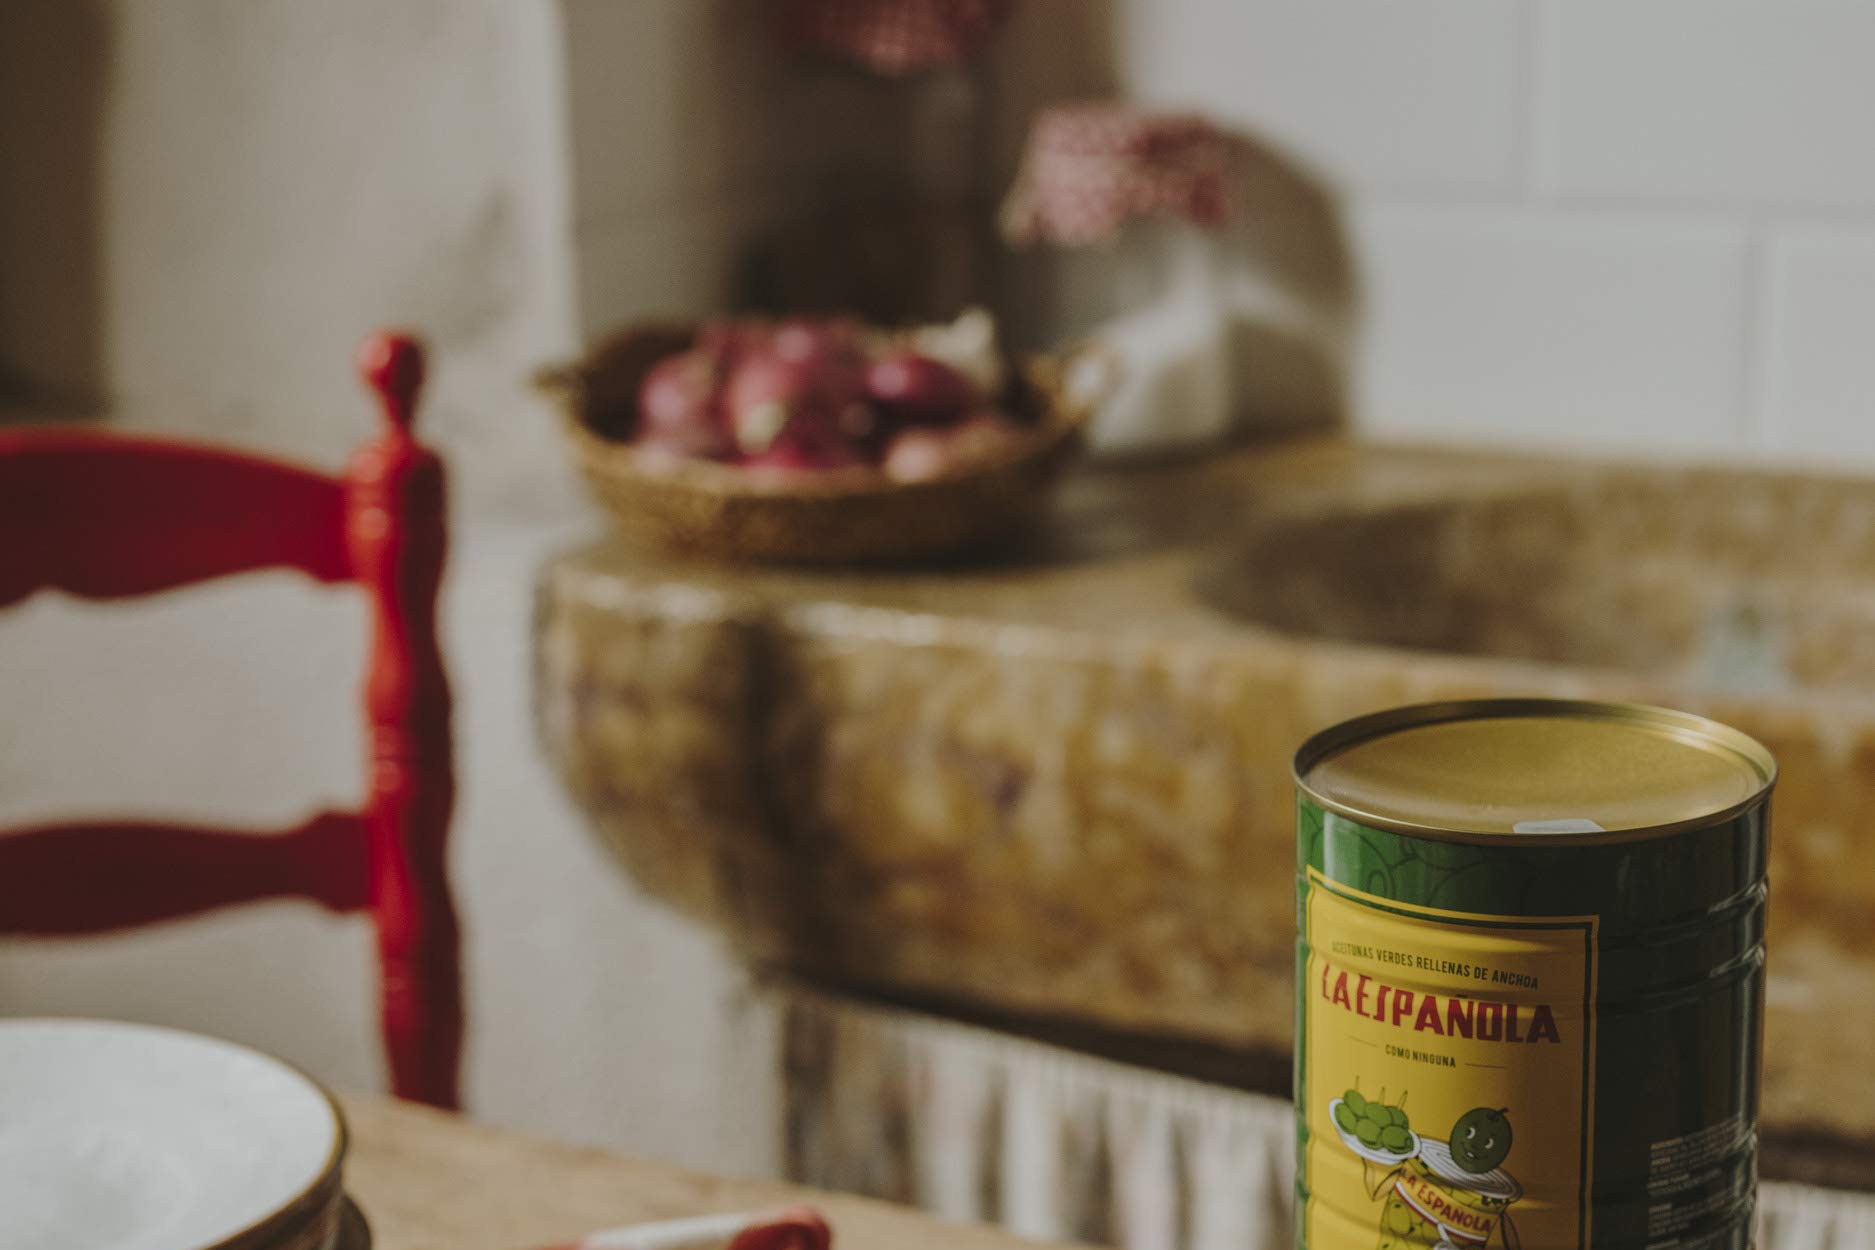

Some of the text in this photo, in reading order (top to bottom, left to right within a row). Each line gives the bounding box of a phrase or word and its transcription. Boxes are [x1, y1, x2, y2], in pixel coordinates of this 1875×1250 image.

[1376, 949, 1413, 967] VERDES
[1416, 956, 1470, 977] RELLENAS
[1474, 966, 1488, 980] DE
[1492, 969, 1538, 989] ANCHOA
[1356, 973, 1561, 1043] ESPAÑOLA
[1385, 1044, 1456, 1068] COMO NINGUNA
[1401, 1168, 1492, 1233] LA ESPAÑOLA
